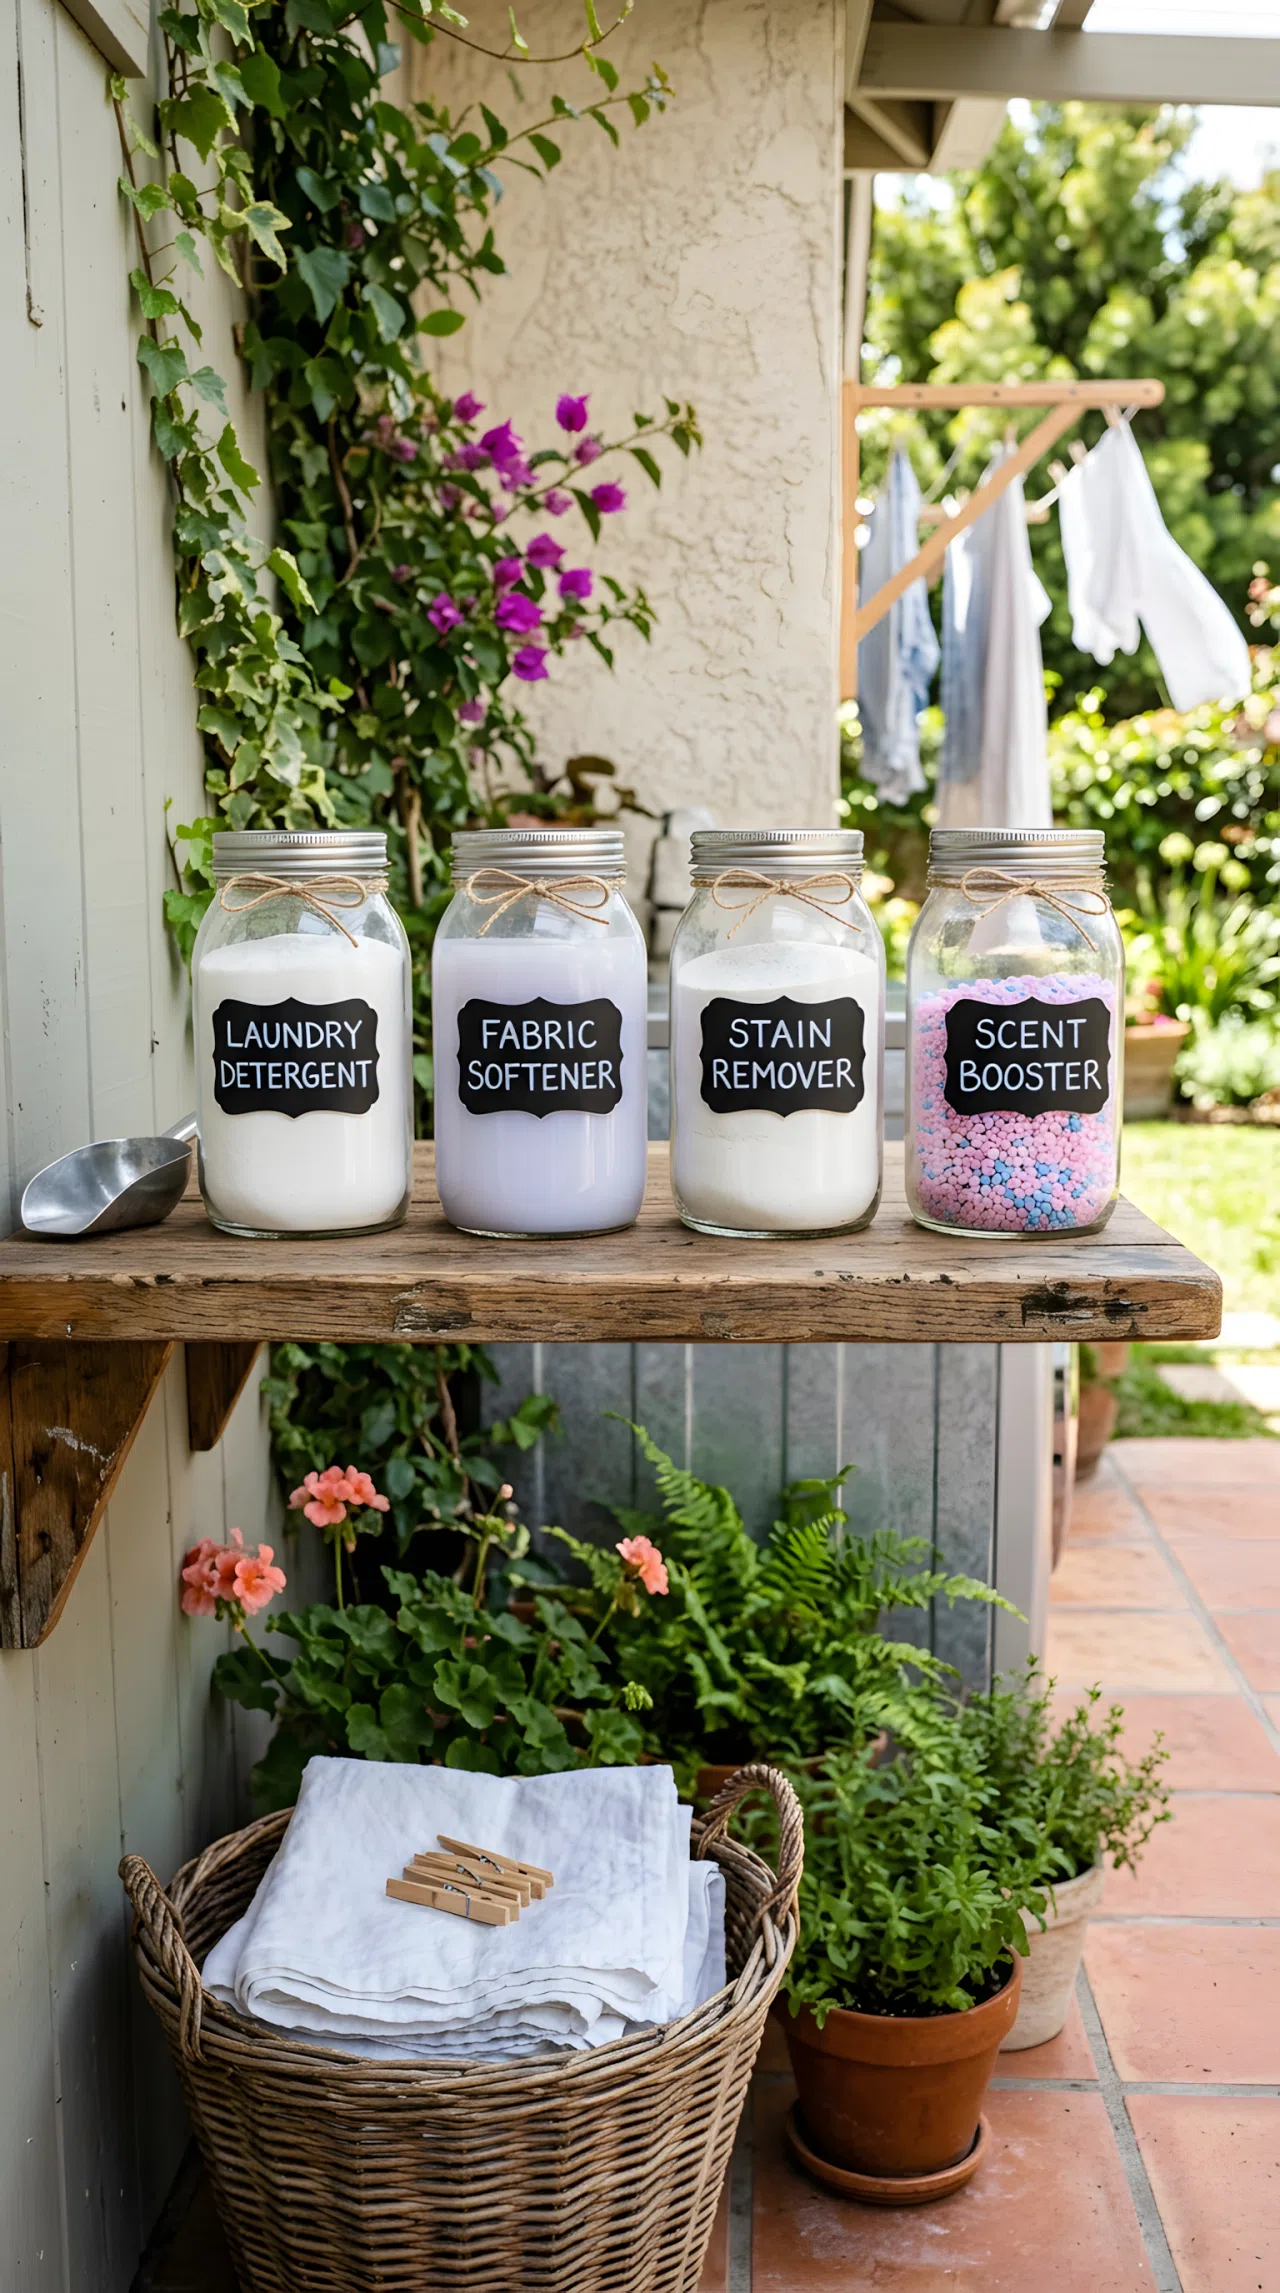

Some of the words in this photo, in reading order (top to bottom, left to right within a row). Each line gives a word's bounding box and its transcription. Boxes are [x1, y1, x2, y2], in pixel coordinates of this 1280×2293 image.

[227, 1019, 363, 1050] LAUNDRY
[482, 1019, 598, 1050] FABRIC
[728, 1018, 831, 1049] STAIN
[975, 1018, 1087, 1049] SCENT
[220, 1059, 373, 1089] DETERGENT
[467, 1059, 616, 1091] SOFTENER
[712, 1058, 856, 1089] REMOVER
[960, 1059, 1102, 1092] BOOSTER
